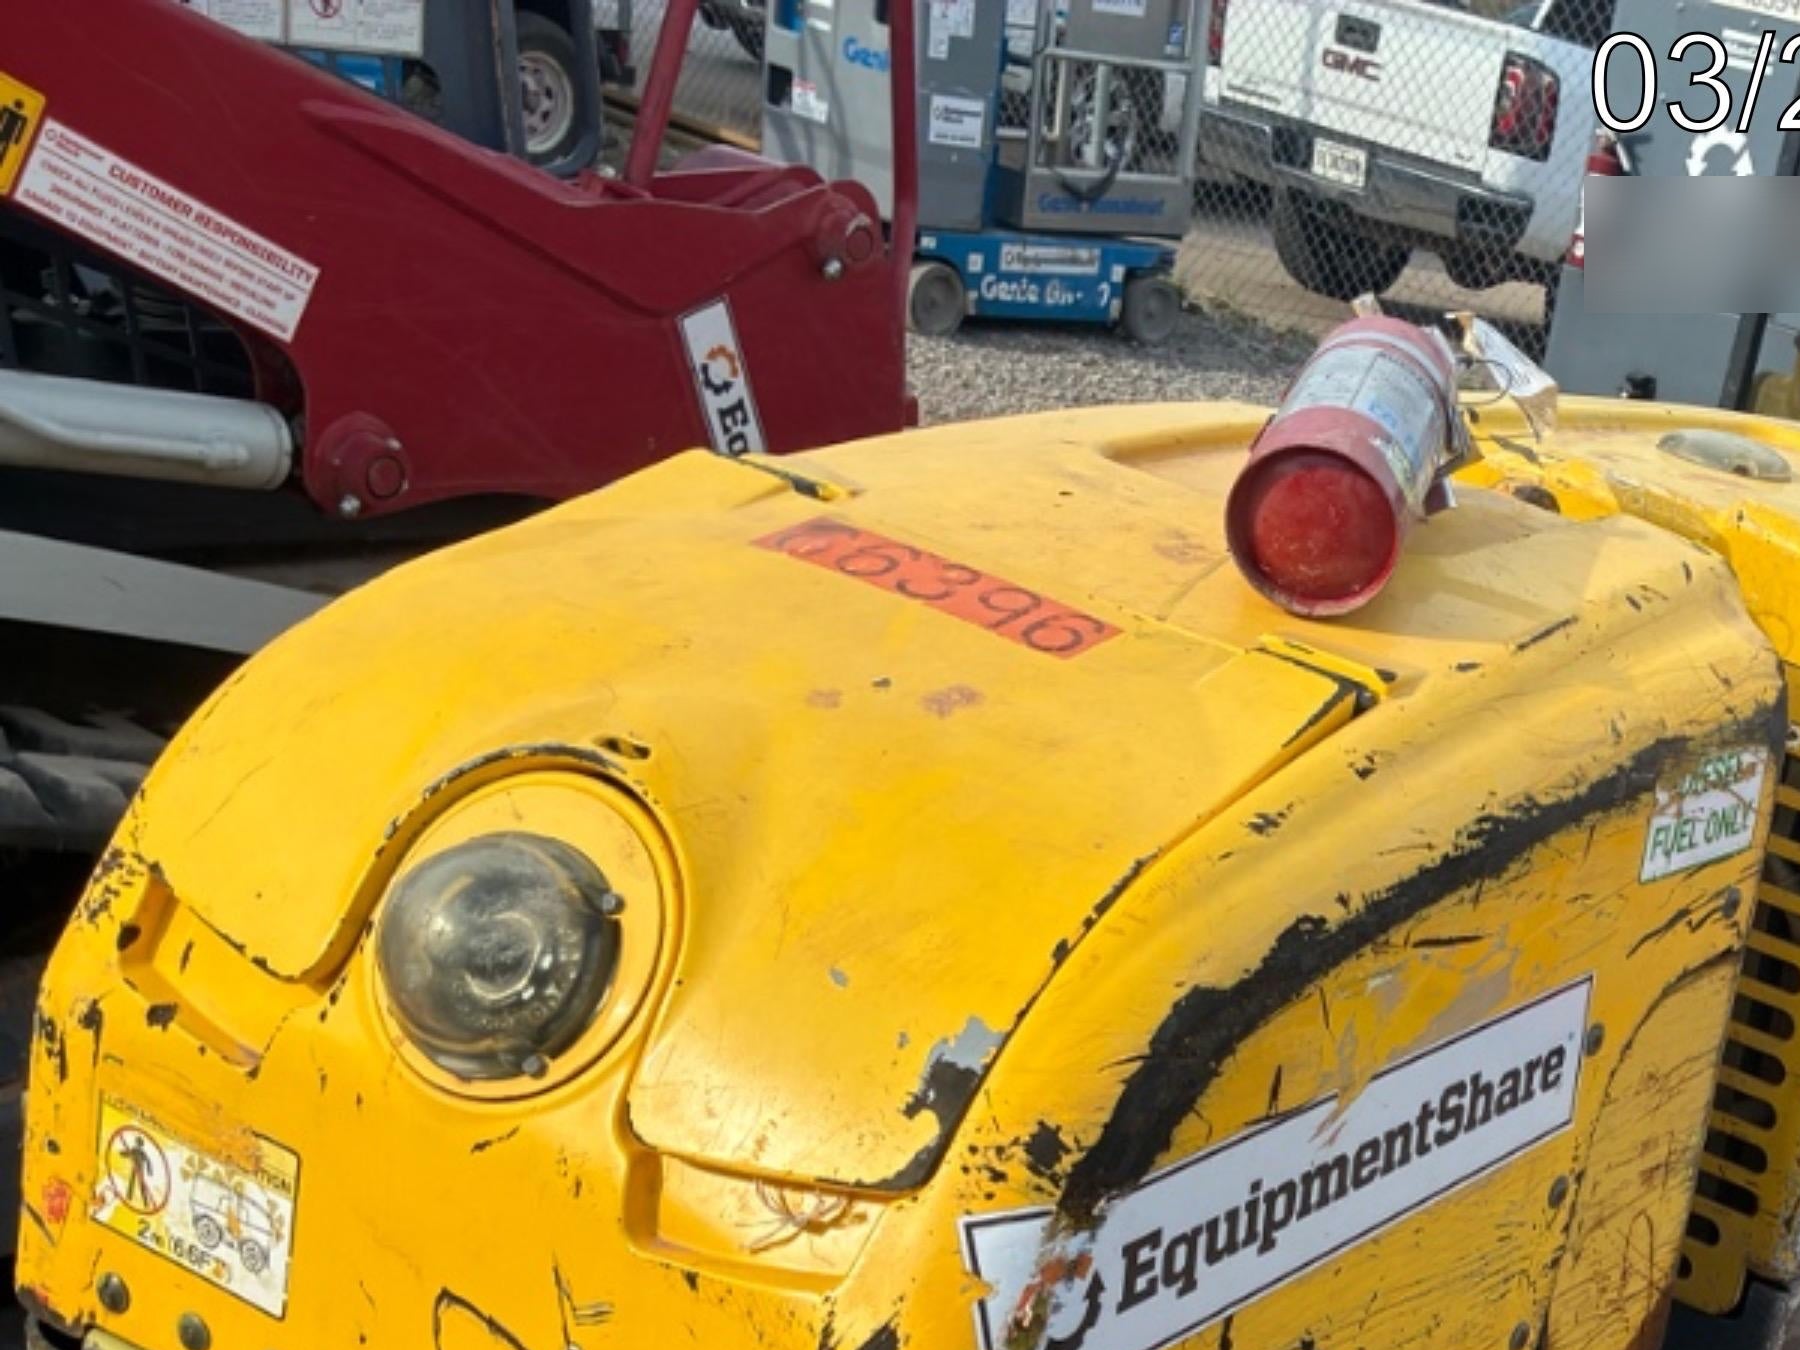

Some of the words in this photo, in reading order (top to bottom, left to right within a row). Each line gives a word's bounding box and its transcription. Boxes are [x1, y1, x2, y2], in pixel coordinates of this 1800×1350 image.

[1322, 48, 1381, 81] GMC
[107, 164, 194, 218] CUSTOMER
[194, 211, 316, 284] RESPONSIBILITY
[1650, 815, 1698, 862] FUEL
[1703, 798, 1759, 844] ONLY
[1116, 1043, 1566, 1315] EquipmentShare
